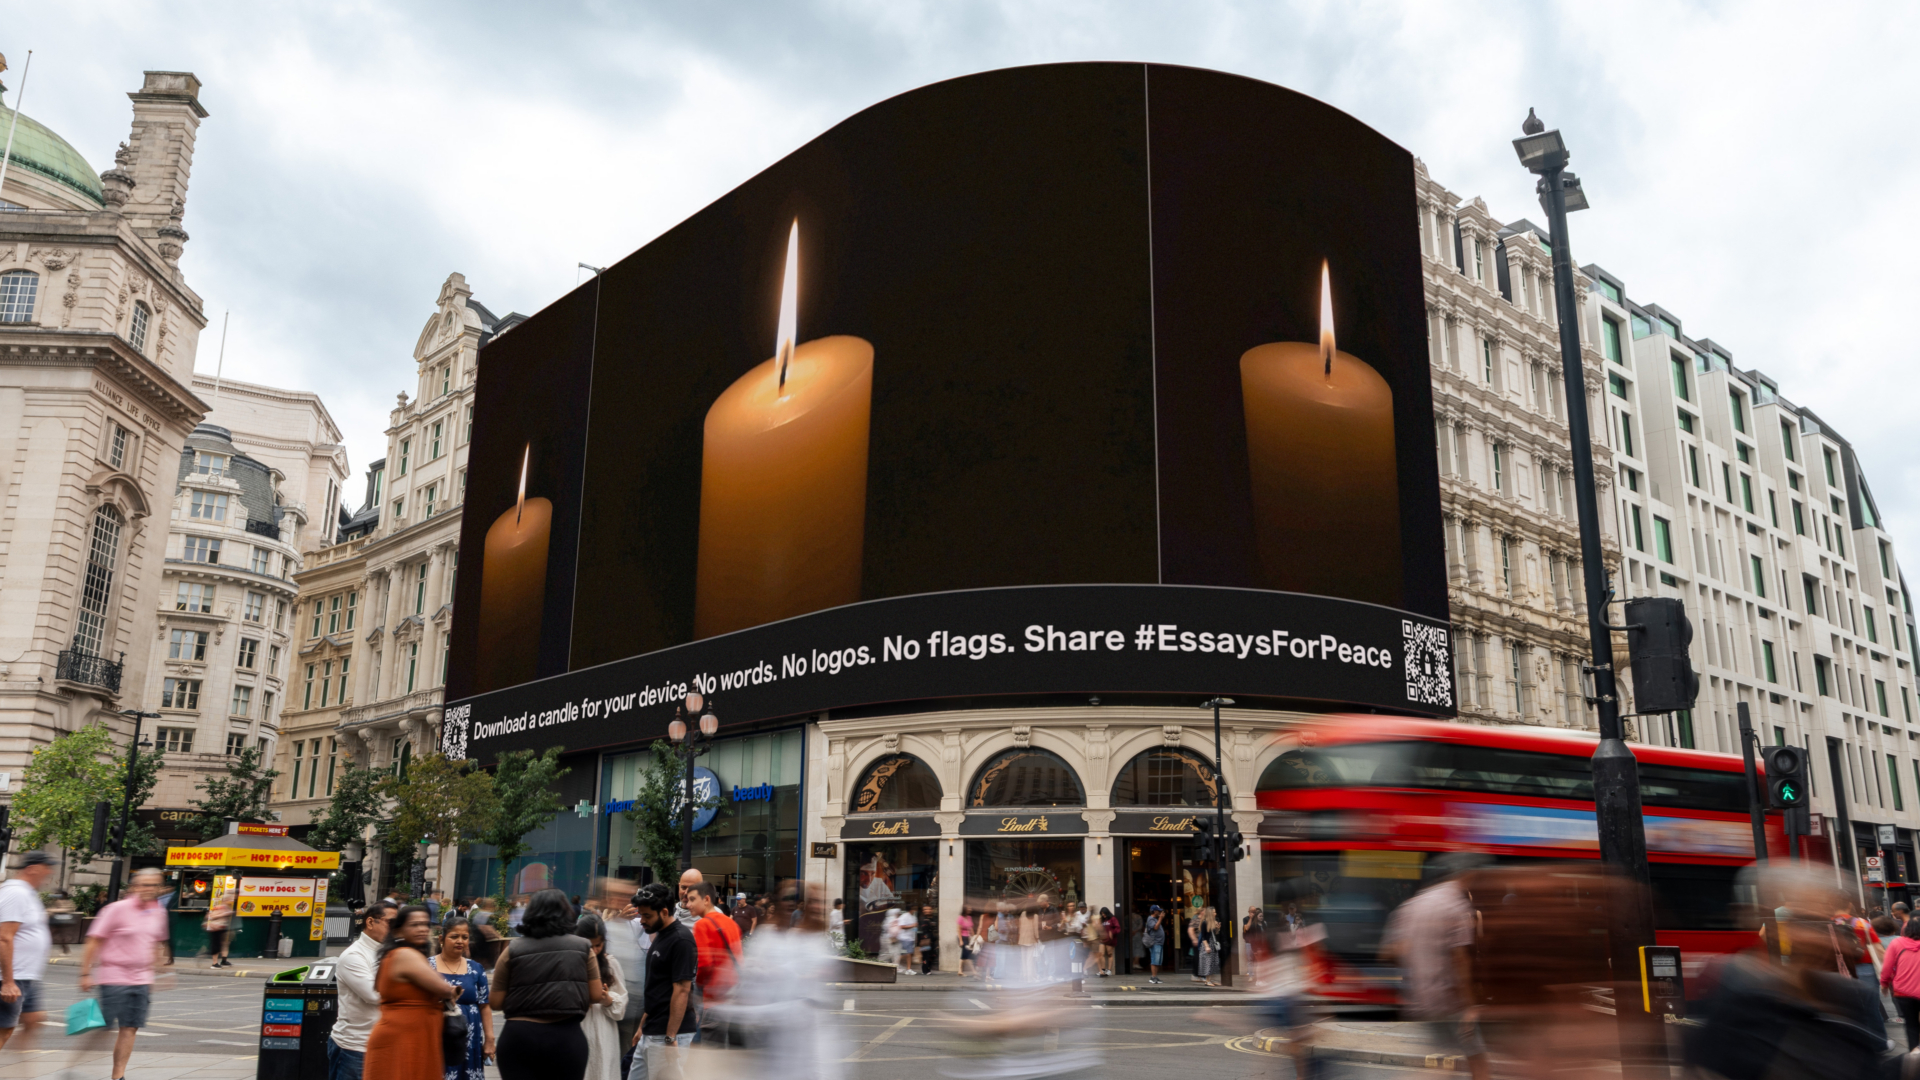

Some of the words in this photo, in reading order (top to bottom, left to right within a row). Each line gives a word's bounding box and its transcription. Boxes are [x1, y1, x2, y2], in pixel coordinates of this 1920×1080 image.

[95, 380, 123, 406] ALLIANCE
[127, 402, 139, 417] LIFE
[143, 413, 161, 432] OFFICE
[473, 711, 528, 740] Download
[528, 714, 537, 730] a
[538, 702, 579, 728] candle
[581, 697, 603, 719] for
[603, 692, 637, 719] your
[695, 673, 717, 695] No
[720, 661, 778, 691] words.
[781, 653, 808, 679] No
[811, 648, 876, 675] logos.
[883, 635, 921, 662] No
[926, 630, 1015, 661] flags.
[1024, 624, 1125, 653] Share
[1134, 624, 1392, 669] #EssaysForPeace
[733, 782, 775, 802] beauty
[605, 798, 651, 817] pharm
[869, 821, 900, 835] Lindt
[997, 817, 1039, 832] Lindt
[1149, 816, 1190, 831] Lindt
[170, 852, 186, 861] HOT
[187, 852, 202, 861] DOG
[203, 852, 223, 861] SPOT
[250, 853, 271, 862] HOT
[273, 854, 293, 863] DOG
[294, 855, 318, 864] SPOT
